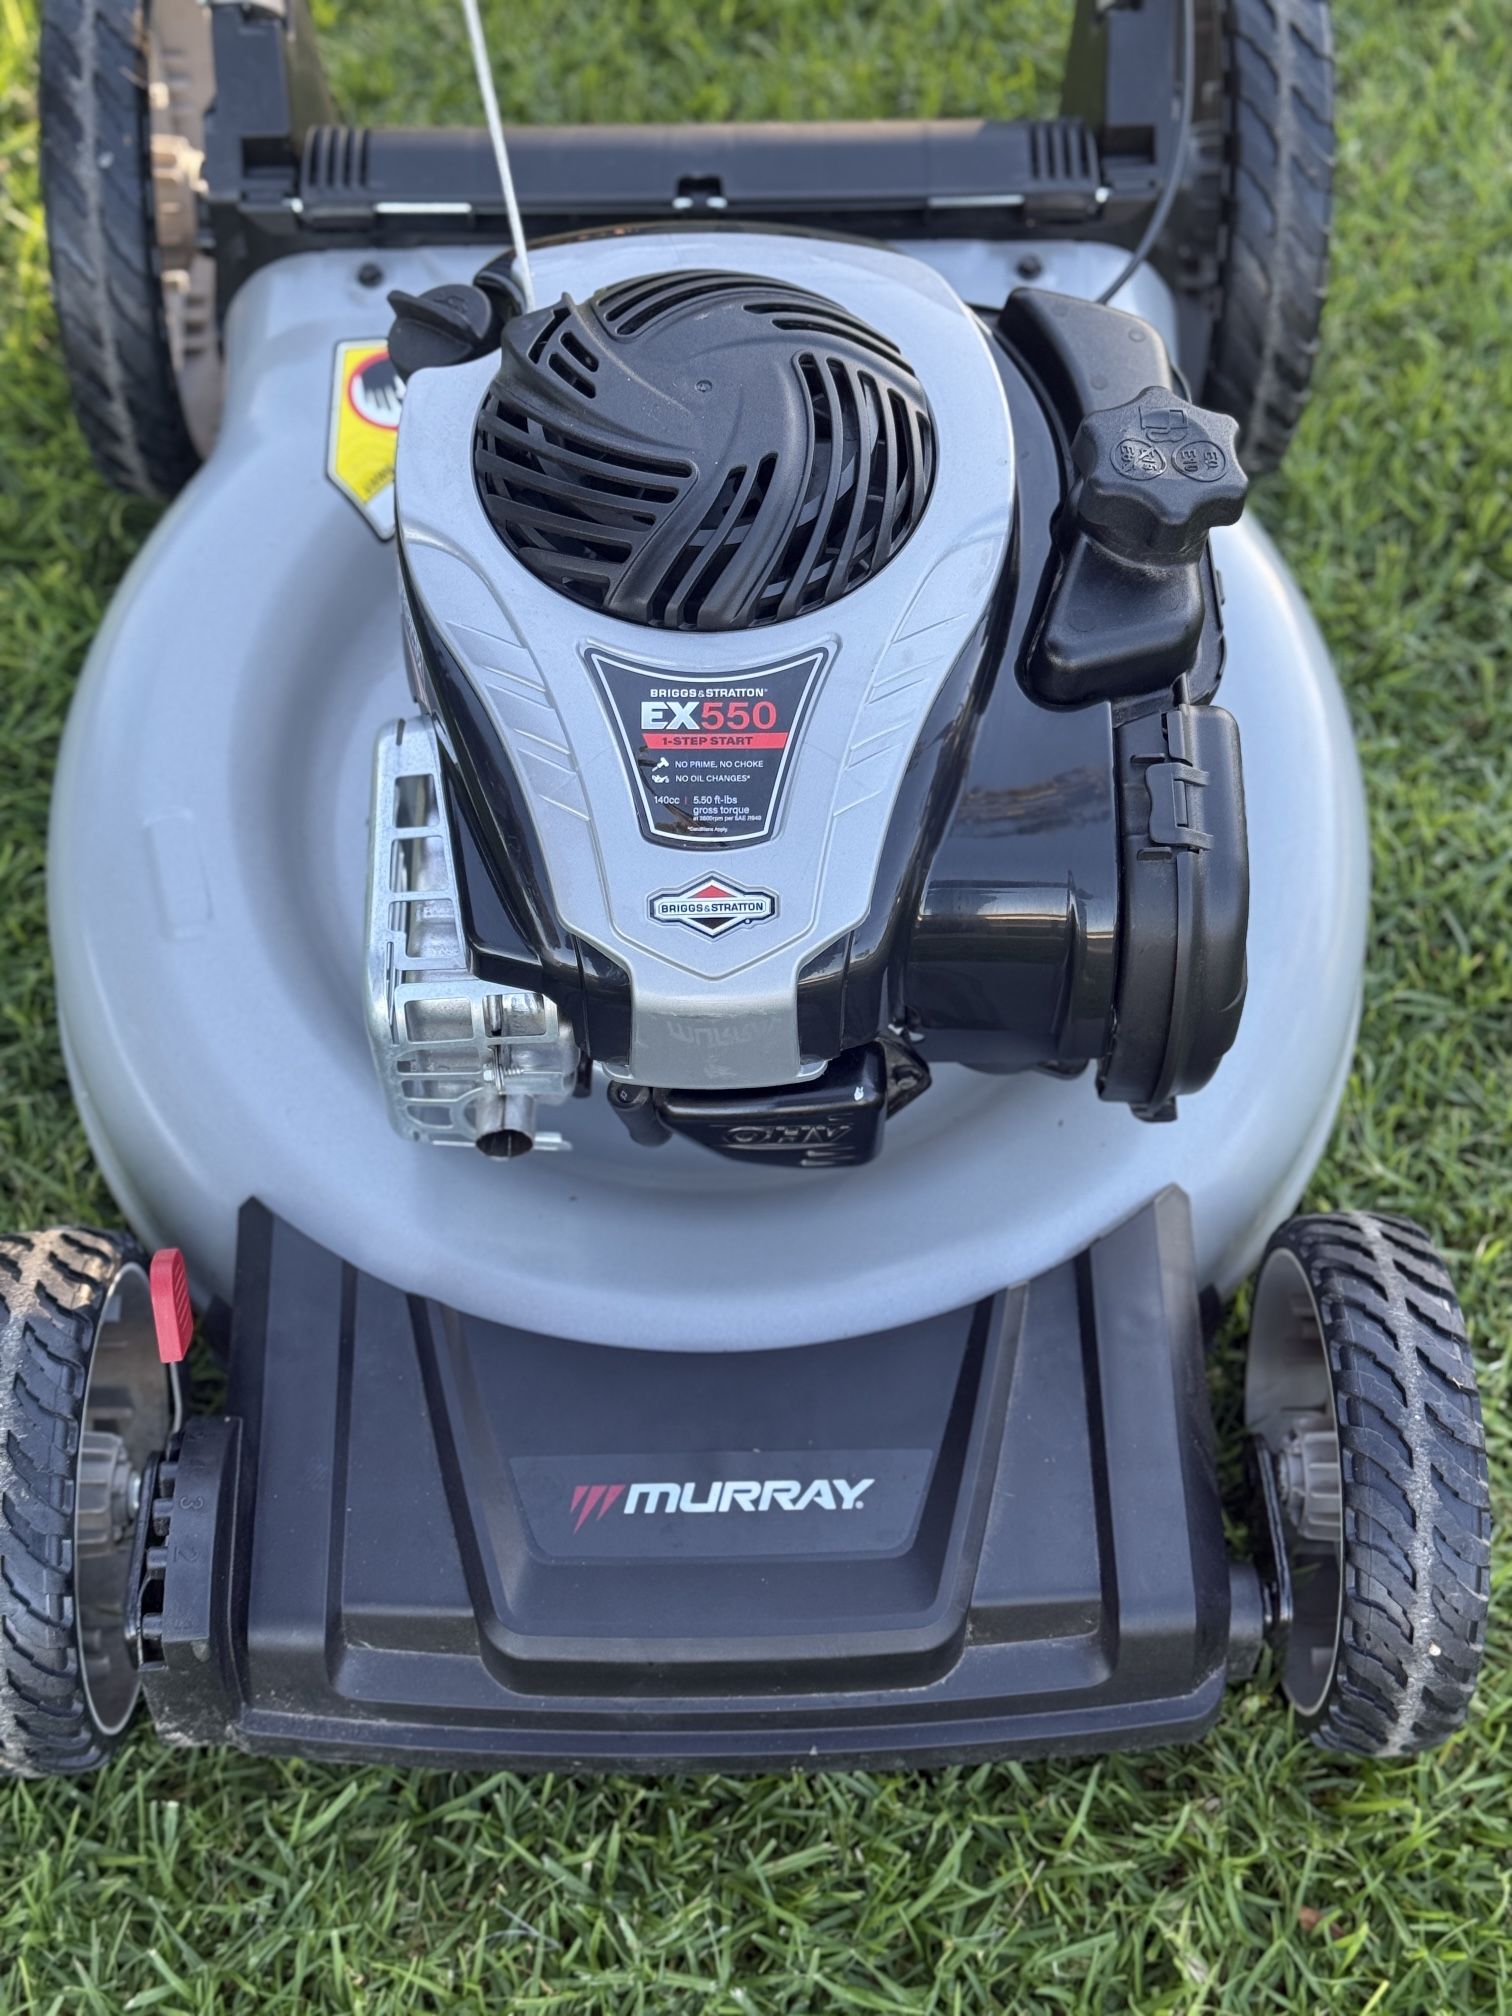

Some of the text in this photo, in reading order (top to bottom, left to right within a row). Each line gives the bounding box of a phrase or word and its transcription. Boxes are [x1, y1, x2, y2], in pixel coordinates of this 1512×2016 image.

[1181, 450, 1200, 473] E10
[650, 688, 764, 698] BRIGGS&STRATTON
[641, 701, 777, 730] EX550
[663, 736, 753, 745] 1-STEP START
[734, 760, 764, 768] CHOKE
[654, 795, 737, 804] 140cc 5.50 ft-lbs
[693, 806, 750, 816] gross torque
[661, 902, 764, 913] BRIGGS&STRATTON
[623, 1478, 876, 1515] MURRAY
[179, 1496, 204, 1510] 3
[172, 1546, 199, 1562] 2
